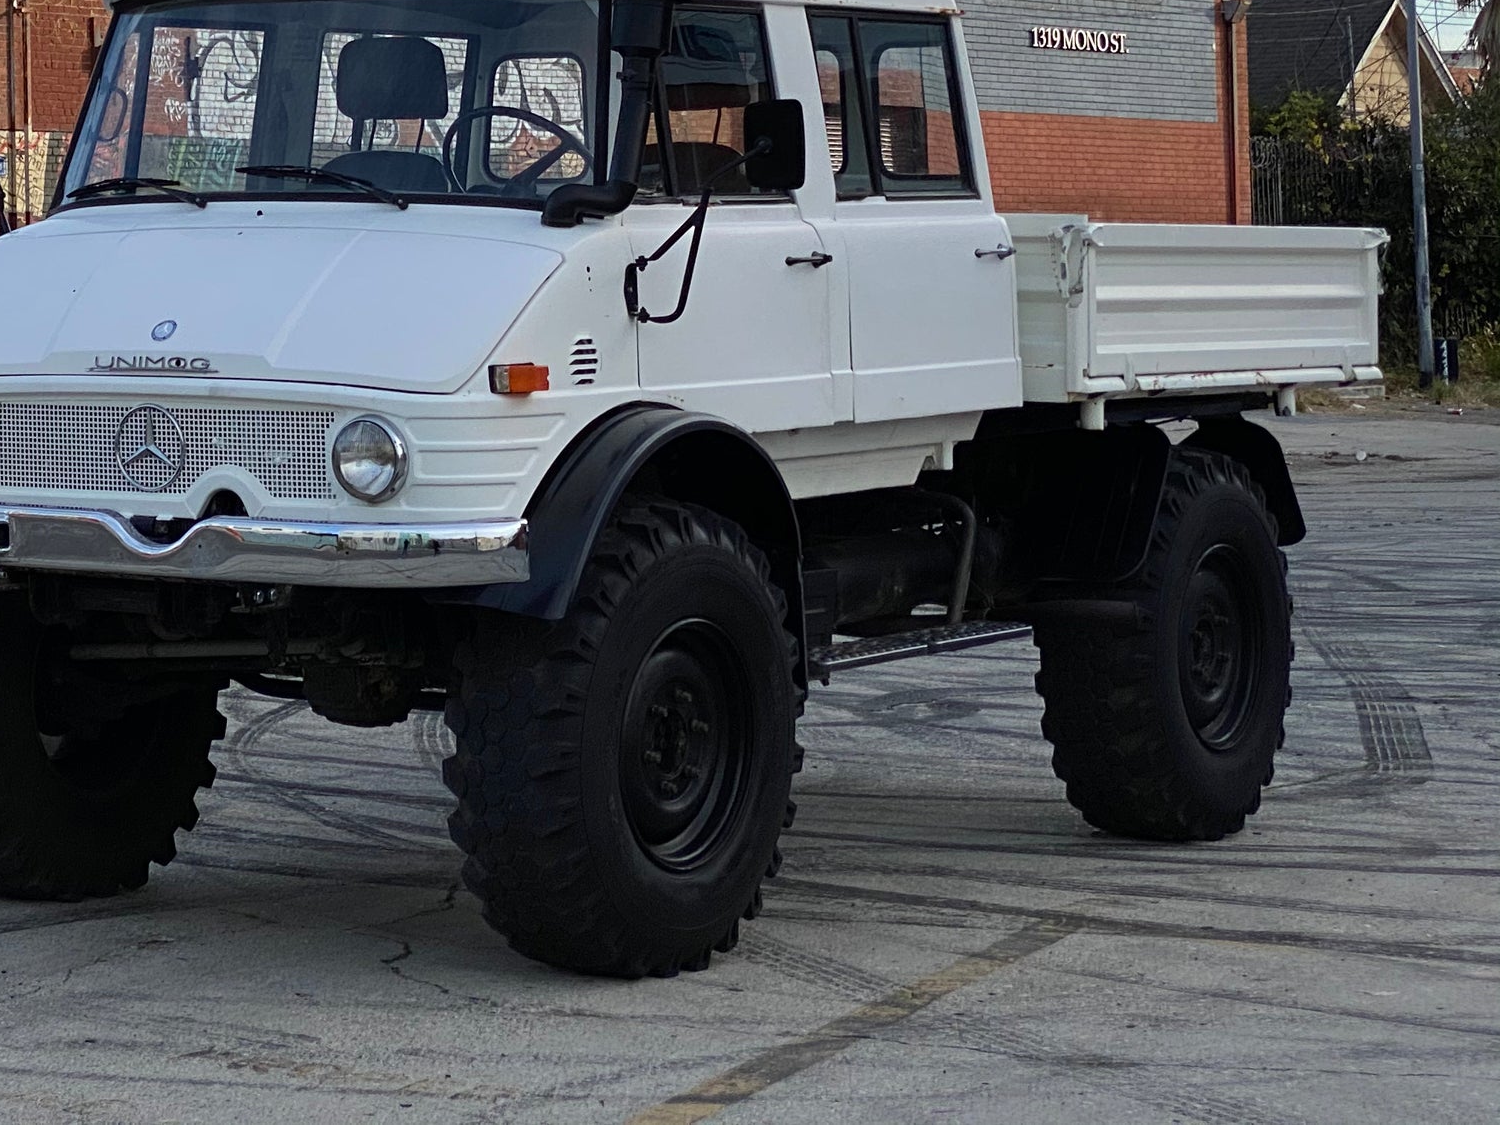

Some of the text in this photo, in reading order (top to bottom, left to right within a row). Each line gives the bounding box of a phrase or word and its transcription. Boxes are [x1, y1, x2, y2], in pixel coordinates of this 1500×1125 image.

[1031, 27, 1130, 54] 1319 MONO ST.
[94, 355, 211, 370] UNIMOG
